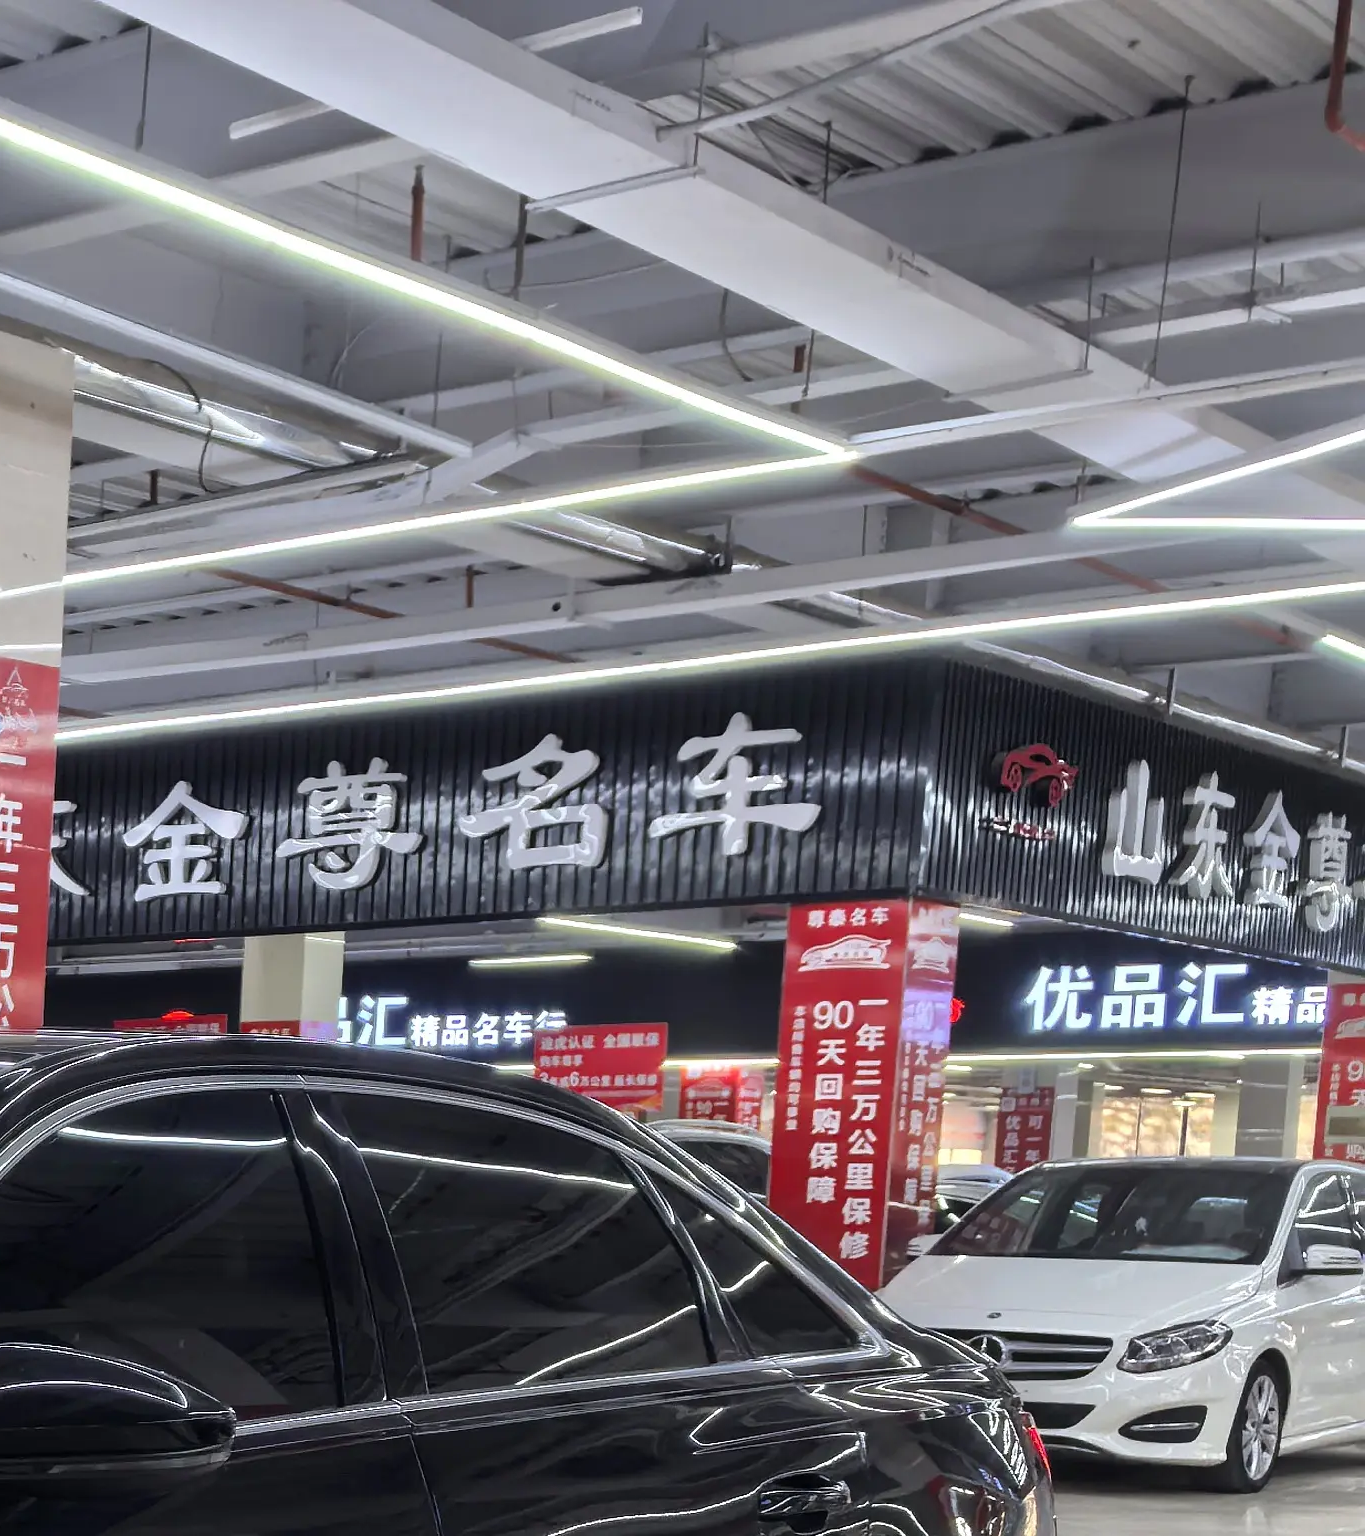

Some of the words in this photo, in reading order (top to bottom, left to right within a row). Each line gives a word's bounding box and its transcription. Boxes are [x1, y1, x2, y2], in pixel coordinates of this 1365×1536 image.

[1101, 758, 1365, 934] 山东金尊
[1025, 962, 1249, 1030] 优品汇
[1250, 985, 1328, 1026] 精品
[805, 1000, 854, 1204] 90天回购保障
[839, 998, 889, 1261] 一年三万公里保修
